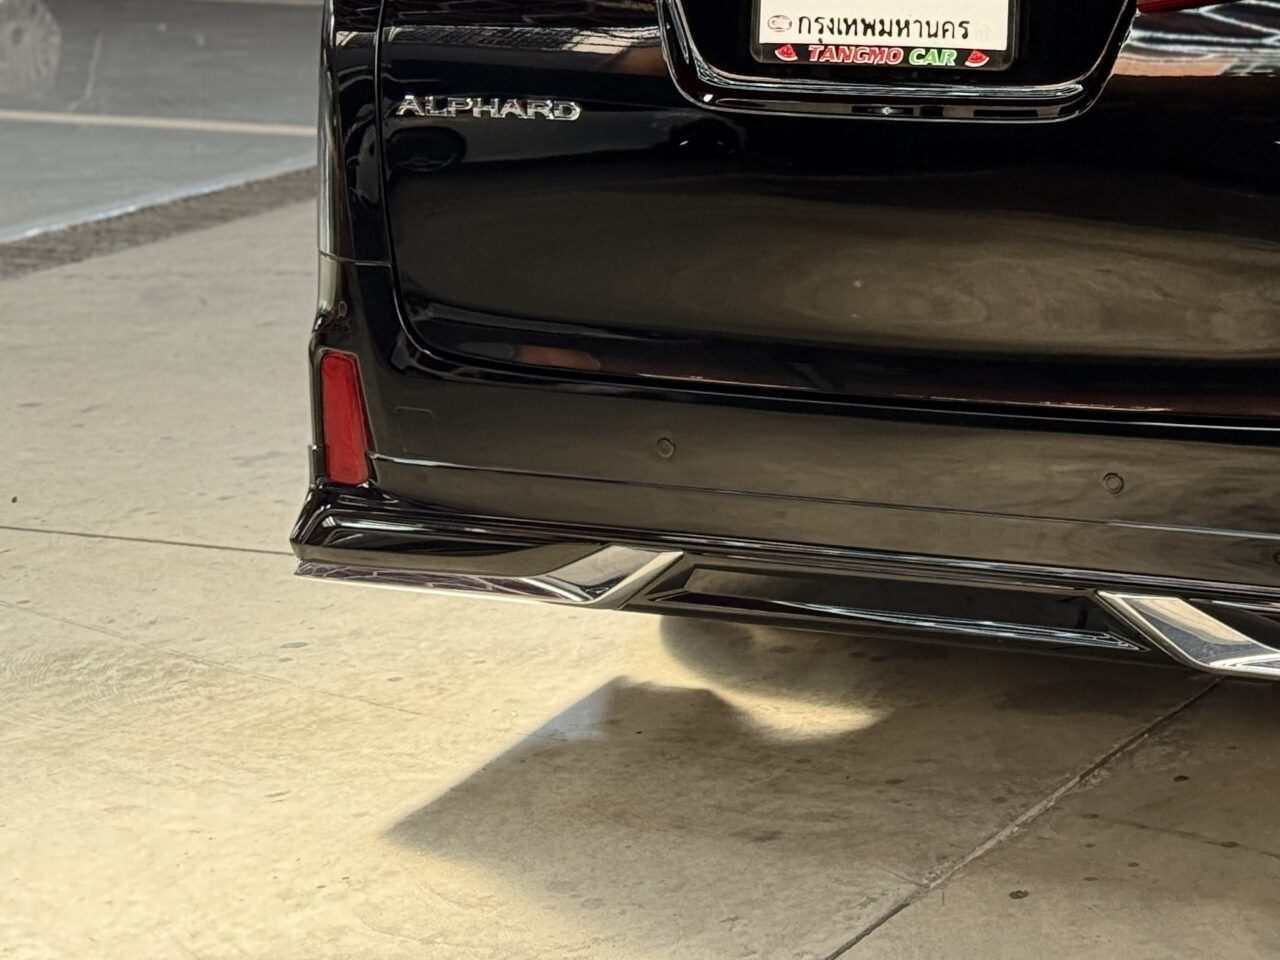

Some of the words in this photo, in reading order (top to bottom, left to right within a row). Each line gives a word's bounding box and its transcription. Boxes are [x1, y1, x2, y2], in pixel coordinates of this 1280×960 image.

[798, 15, 971, 44] กรุงเทพมหานคร
[808, 44, 905, 65] TANGMO
[908, 48, 958, 66] CAR
[395, 94, 583, 121] ALPHARD
